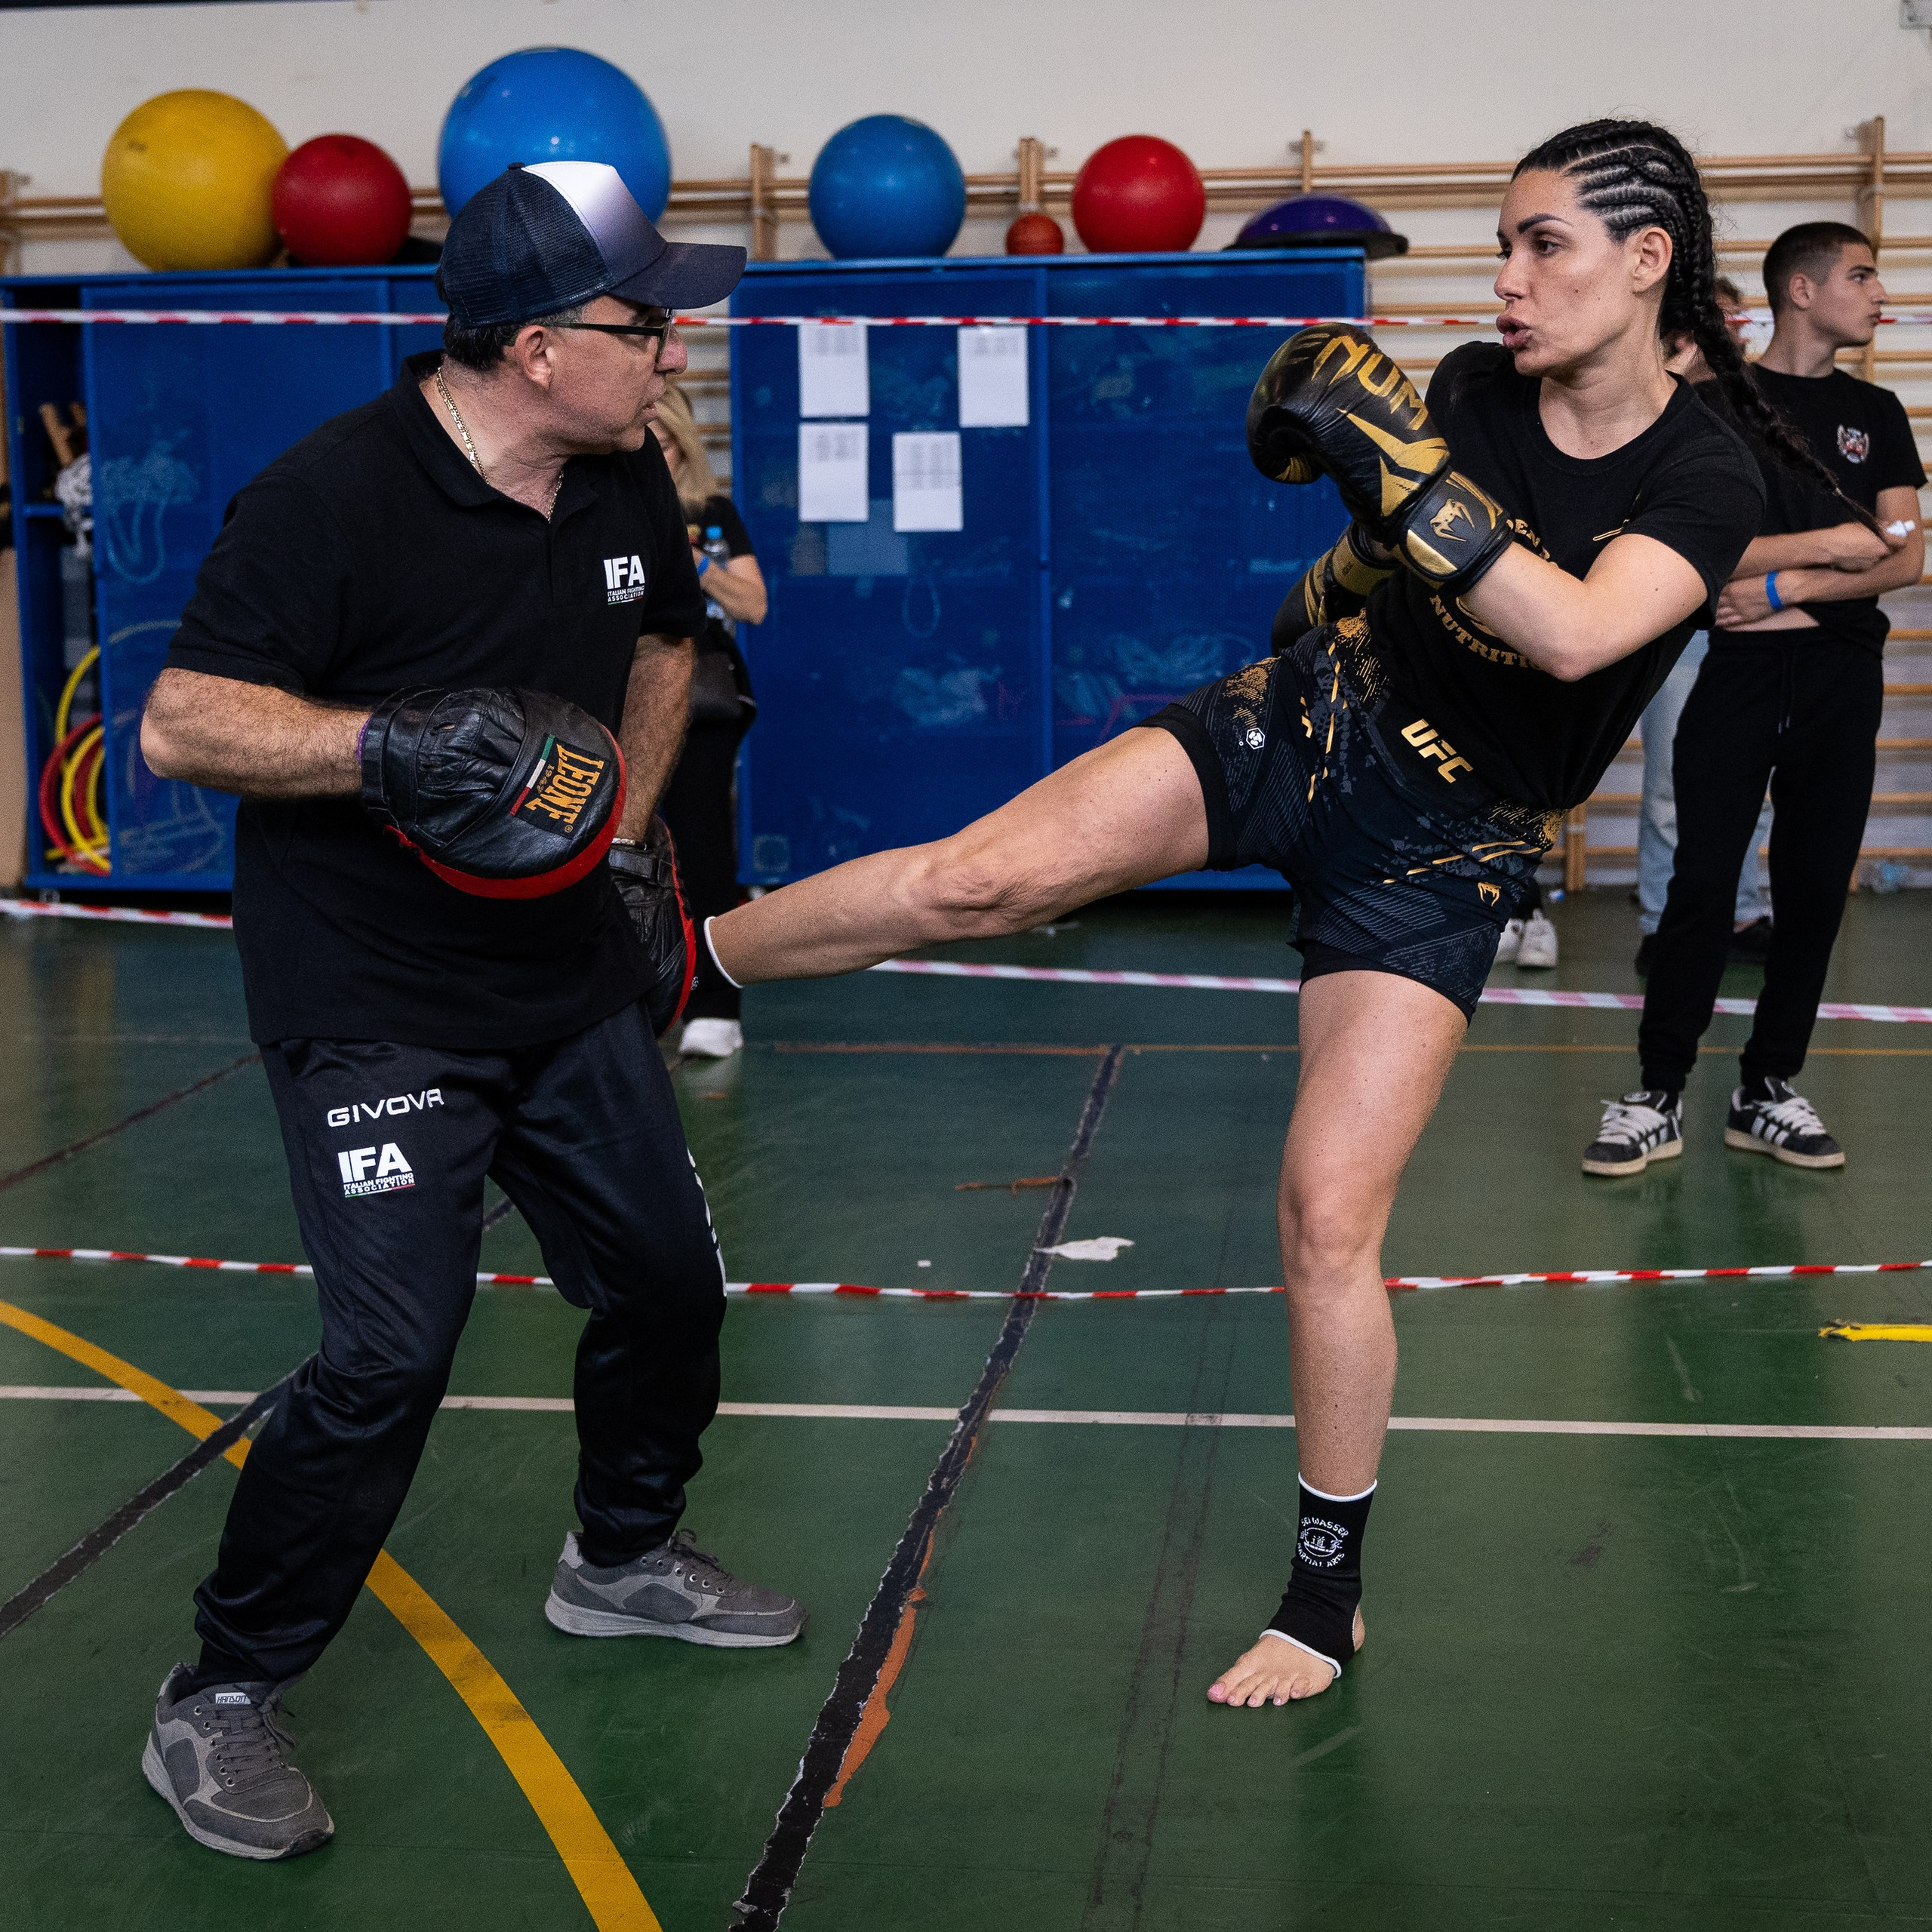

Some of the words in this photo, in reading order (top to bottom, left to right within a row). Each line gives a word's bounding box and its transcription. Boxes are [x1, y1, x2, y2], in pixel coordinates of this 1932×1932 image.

[603, 555, 645, 589] IFA
[607, 589, 627, 597] ITALIAN
[627, 586, 645, 595] FIGHTING
[608, 591, 645, 602] ASSOCIATION
[1429, 595, 1541, 672] NUTRITI
[1401, 718, 1474, 783] UFC
[525, 743, 605, 824] LEONE
[327, 1088, 445, 1128] GIVOVA
[337, 1142, 413, 1183] IFA
[343, 1180, 375, 1191] ITALIAN
[375, 1173, 414, 1185] FIGHTING
[344, 1178, 415, 1195] ASSOCIATION
[1297, 1543, 1324, 1567] MARTIAL
[1327, 1552, 1345, 1567] ARTS
